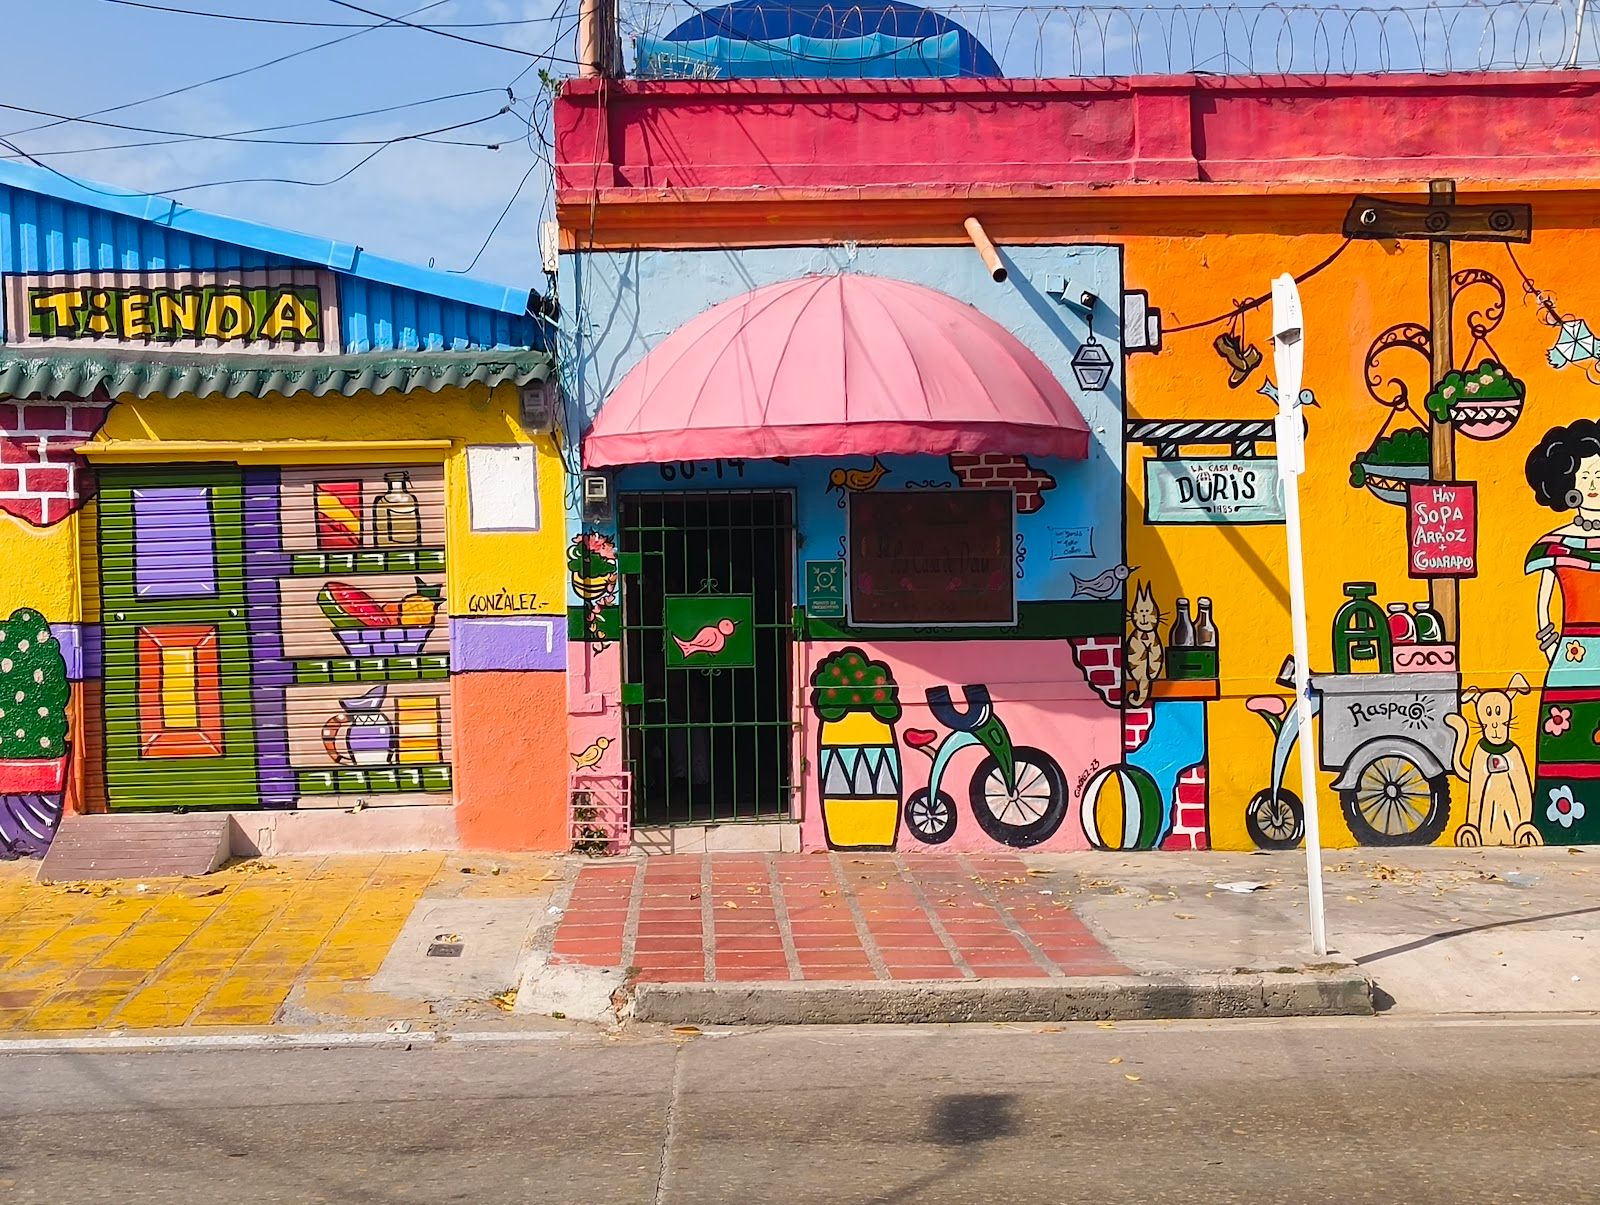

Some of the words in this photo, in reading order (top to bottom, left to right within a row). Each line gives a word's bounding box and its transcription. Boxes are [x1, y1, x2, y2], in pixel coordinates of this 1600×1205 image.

[660, 457, 745, 481] 60-14
[1191, 464, 1204, 473] LA
[1208, 464, 1229, 472] CASA
